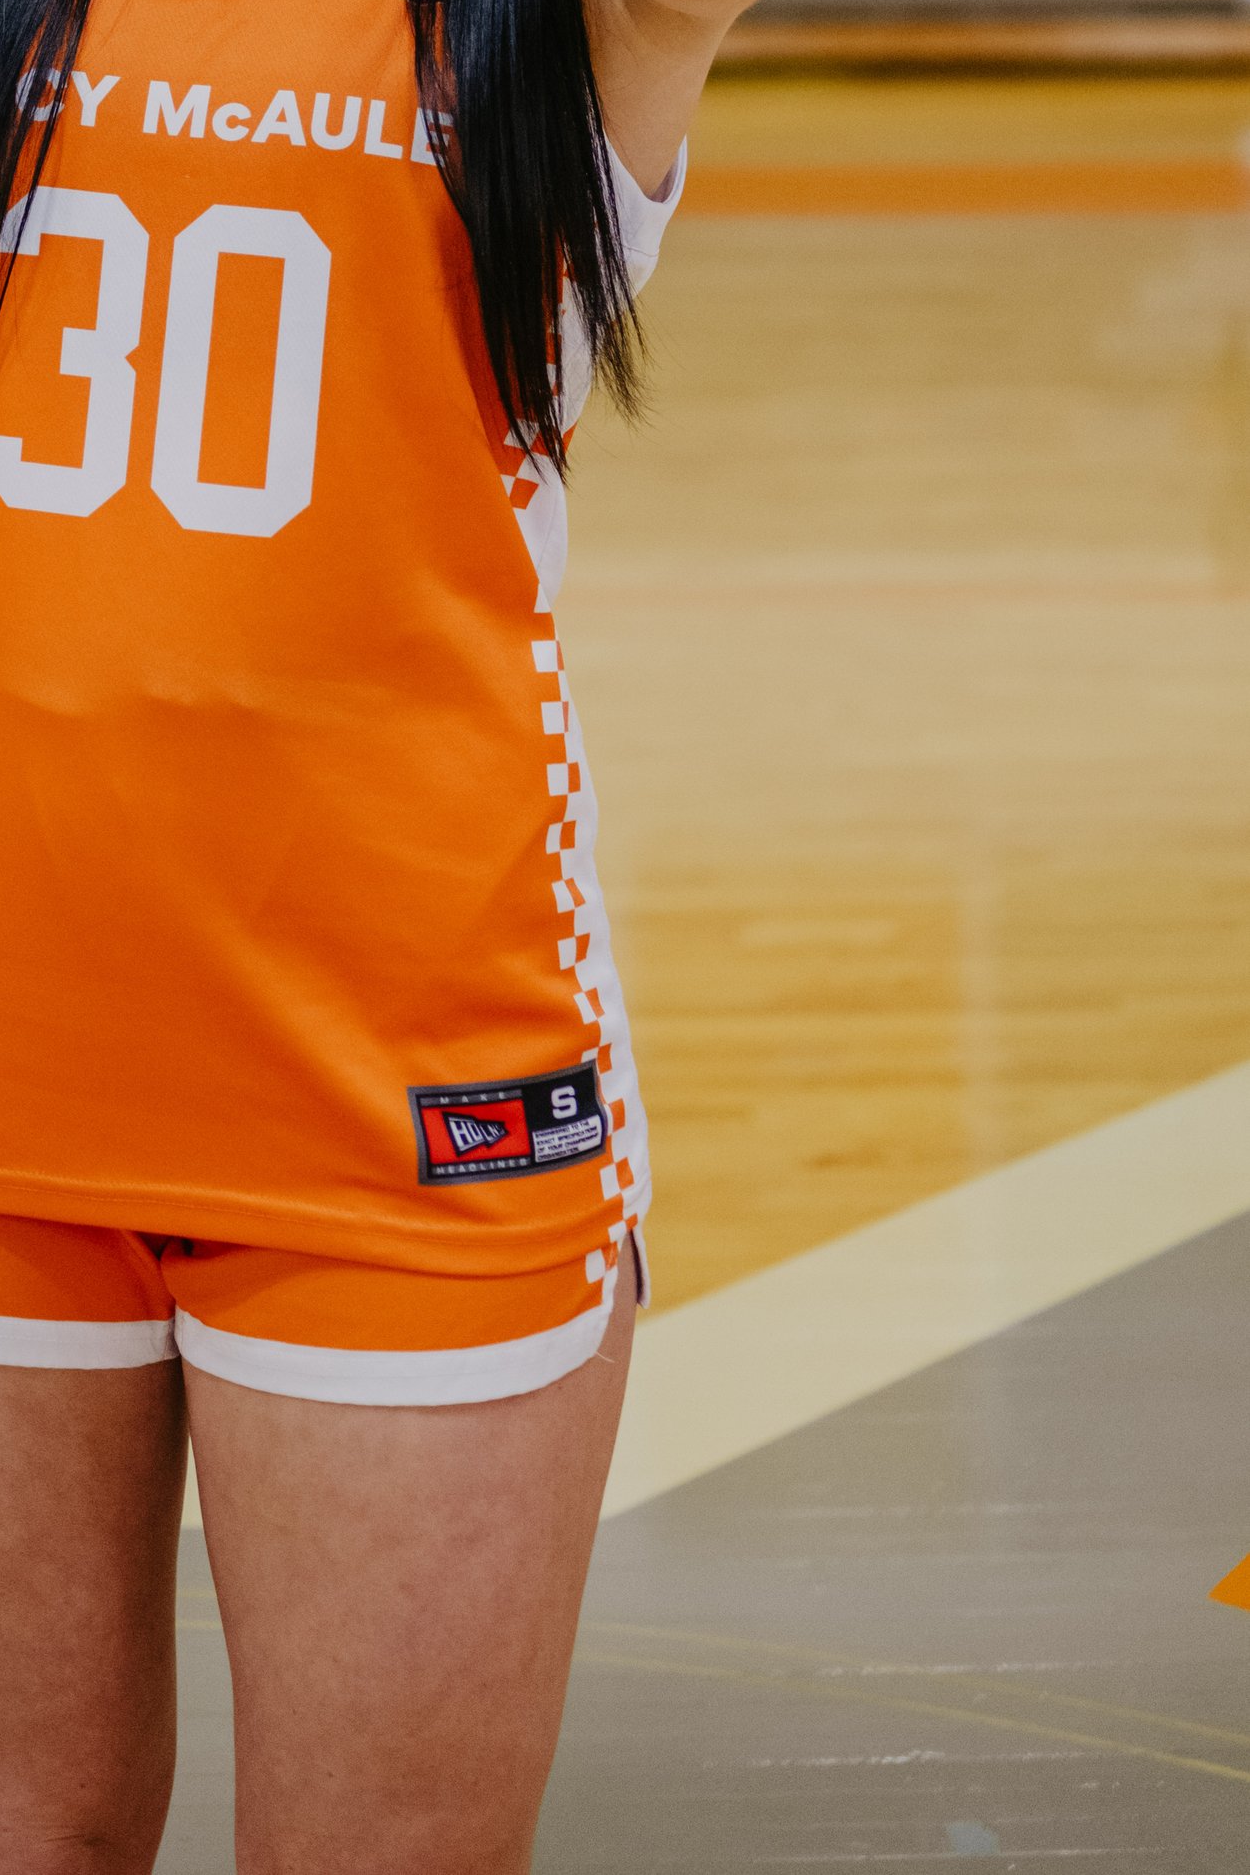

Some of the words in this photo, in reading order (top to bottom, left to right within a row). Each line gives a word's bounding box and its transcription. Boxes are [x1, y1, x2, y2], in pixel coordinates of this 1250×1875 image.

[142, 80, 456, 169] McAULE
[439, 1091, 506, 1104] MAKE
[551, 1085, 578, 1119] S
